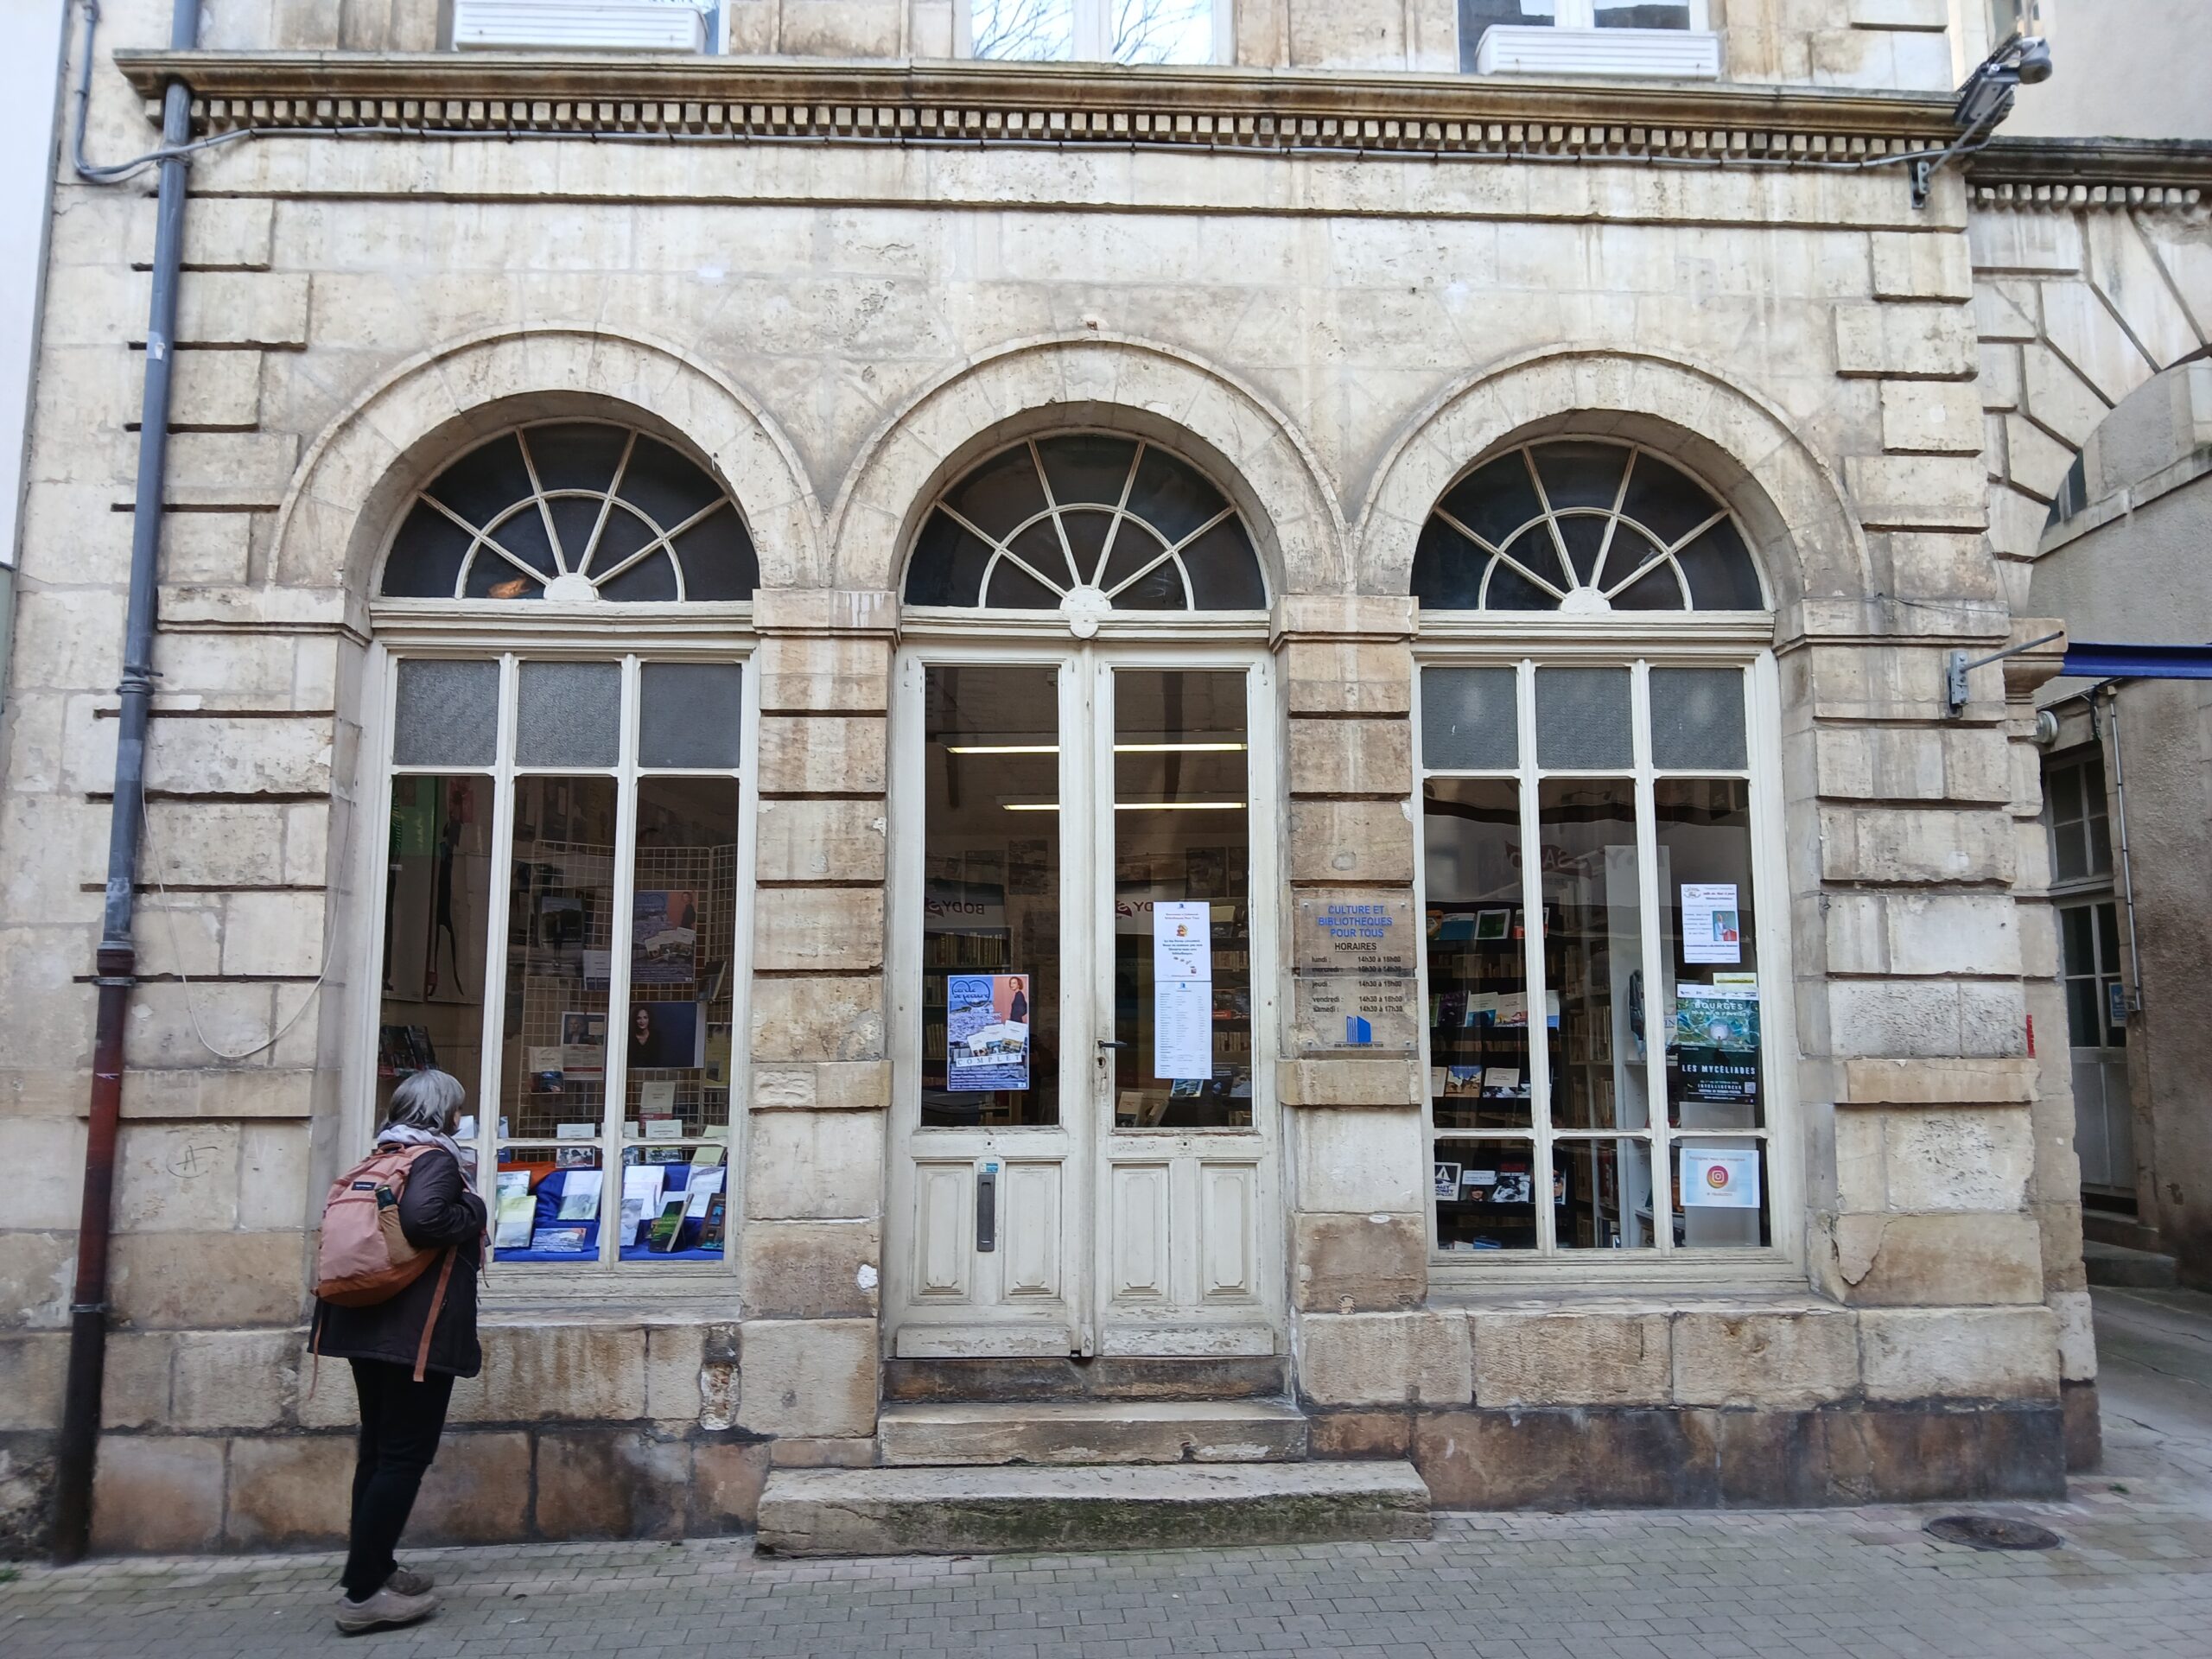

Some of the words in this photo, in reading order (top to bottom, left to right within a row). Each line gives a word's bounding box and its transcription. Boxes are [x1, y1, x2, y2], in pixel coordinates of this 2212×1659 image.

[1328, 906, 1370, 914] CULTURE
[1374, 905, 1384, 914] ET
[1318, 917, 1393, 926] BIBLIOTHEQUES
[1331, 929, 1357, 938] POUR
[1360, 928, 1384, 938] TOUS
[1335, 942, 1377, 950] HORAIRES
[1694, 1001, 1744, 1010] BOURGES
[957, 1055, 1020, 1065] COMPLET
[1681, 1064, 1697, 1072] LES
